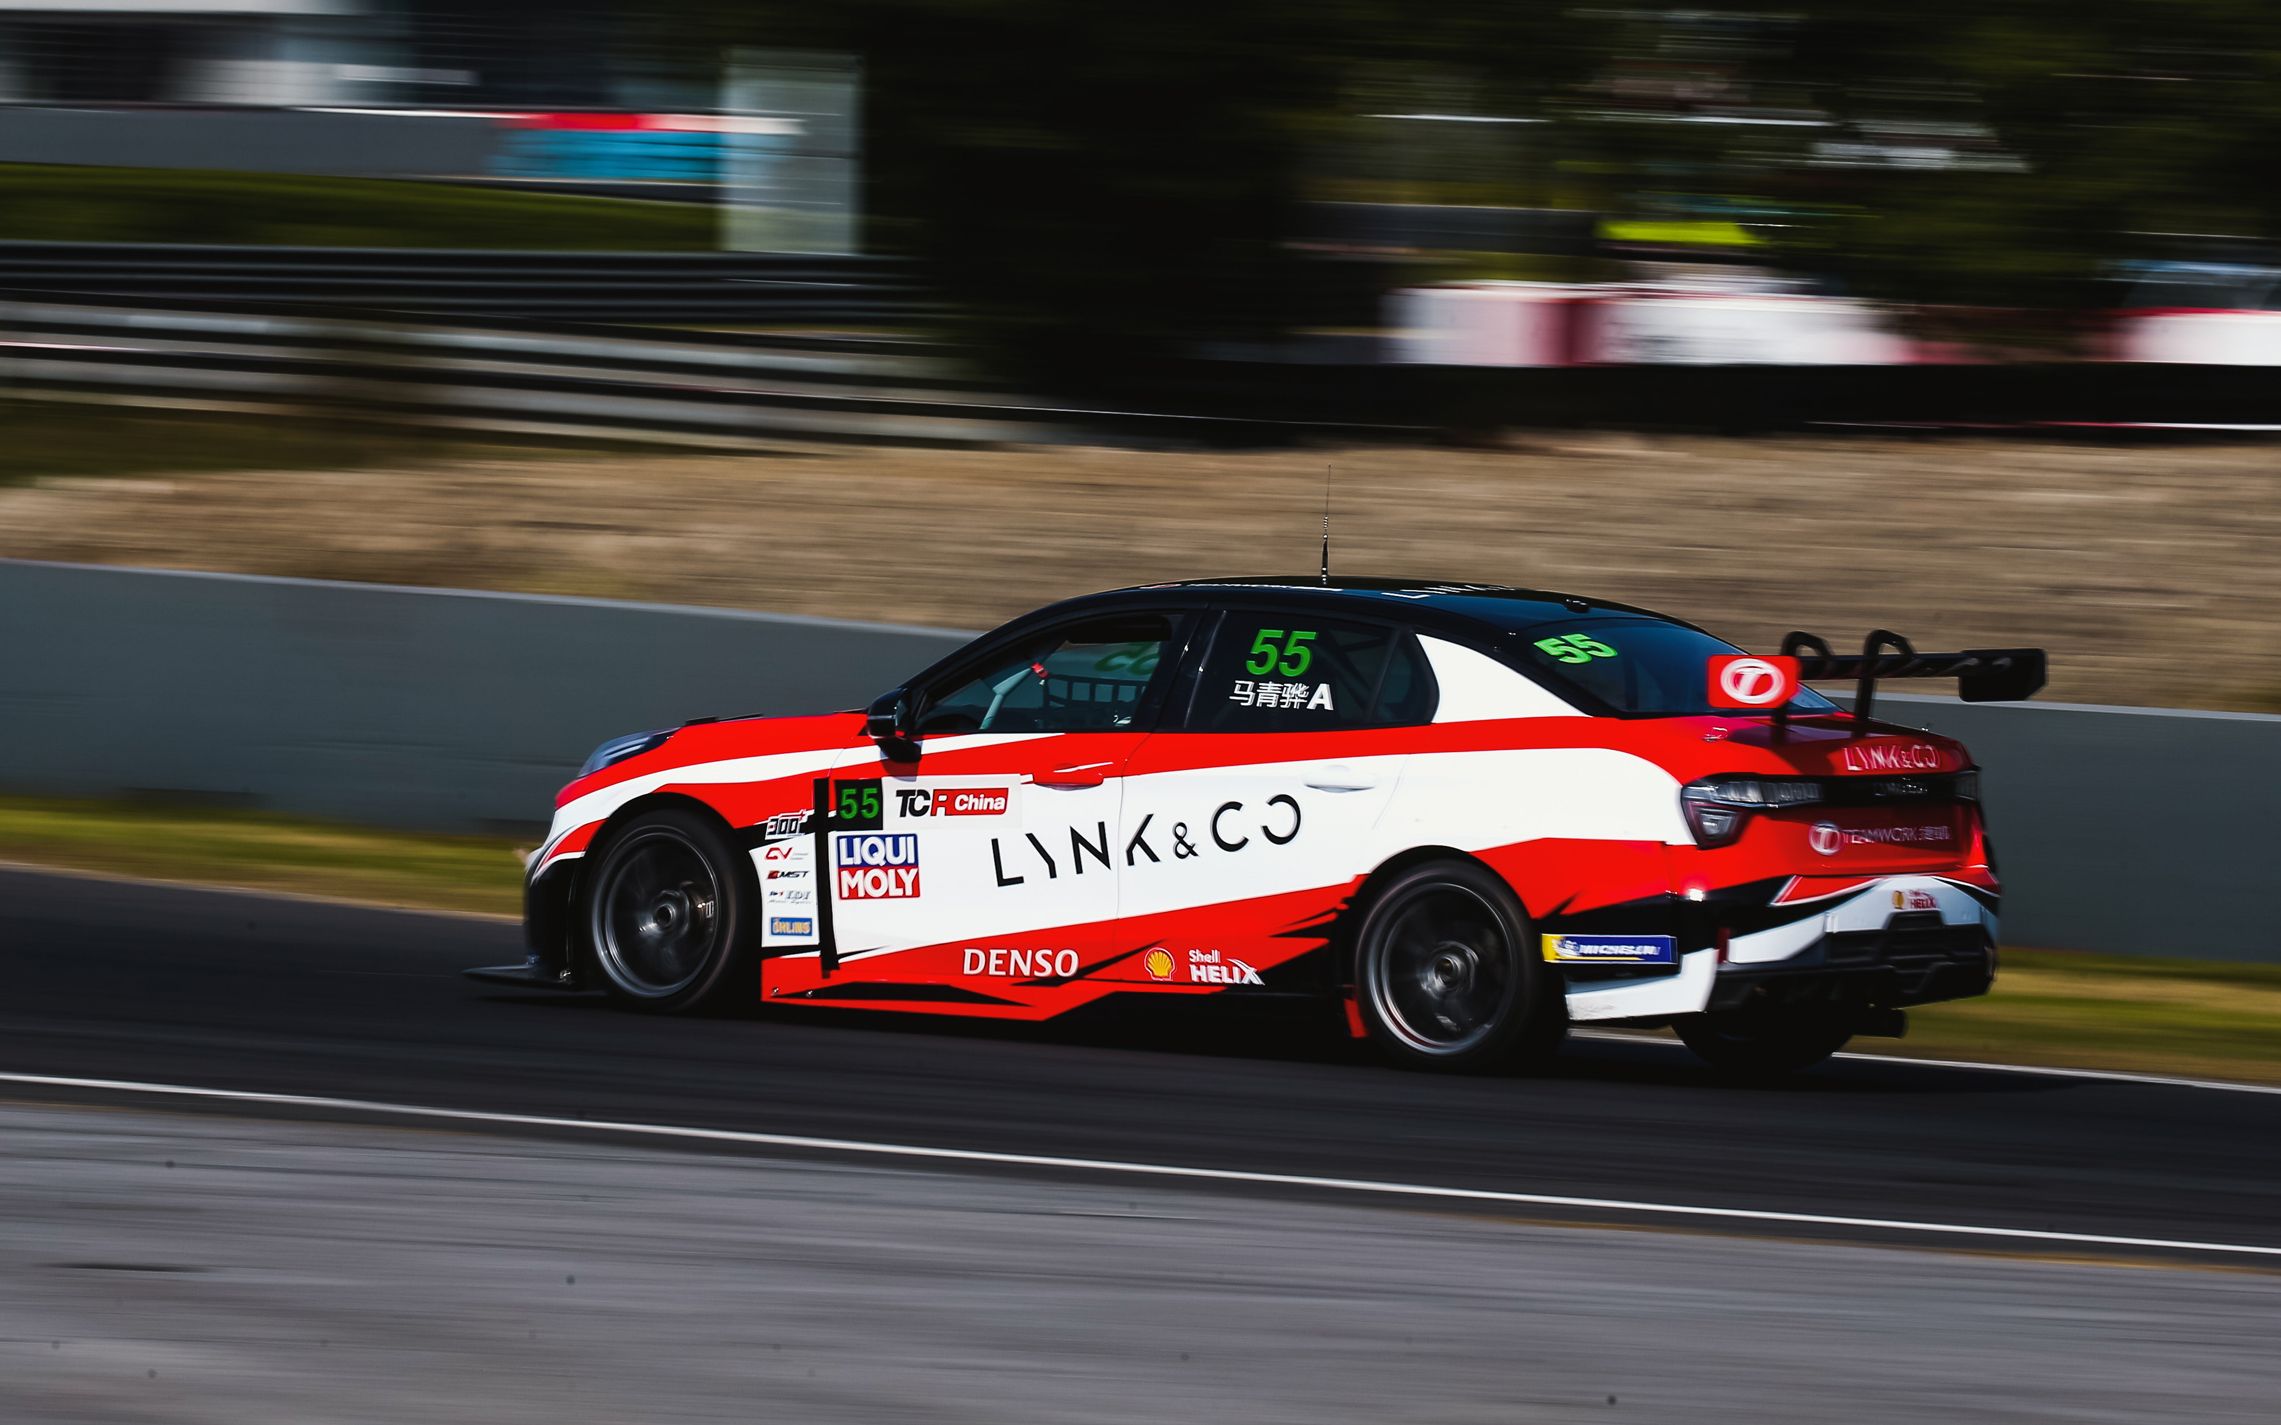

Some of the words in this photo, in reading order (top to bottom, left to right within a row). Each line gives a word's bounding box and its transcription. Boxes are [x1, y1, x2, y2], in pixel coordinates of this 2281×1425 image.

[1246, 629, 1318, 677] 55
[1533, 633, 1618, 664] 55
[840, 788, 880, 819] 55
[954, 794, 1006, 812] China
[838, 836, 916, 867] LIQUI
[840, 867, 919, 898] MOLY
[962, 948, 1080, 978] DENSO
[1189, 949, 1221, 964] Shell
[1189, 958, 1266, 986] HELIX
